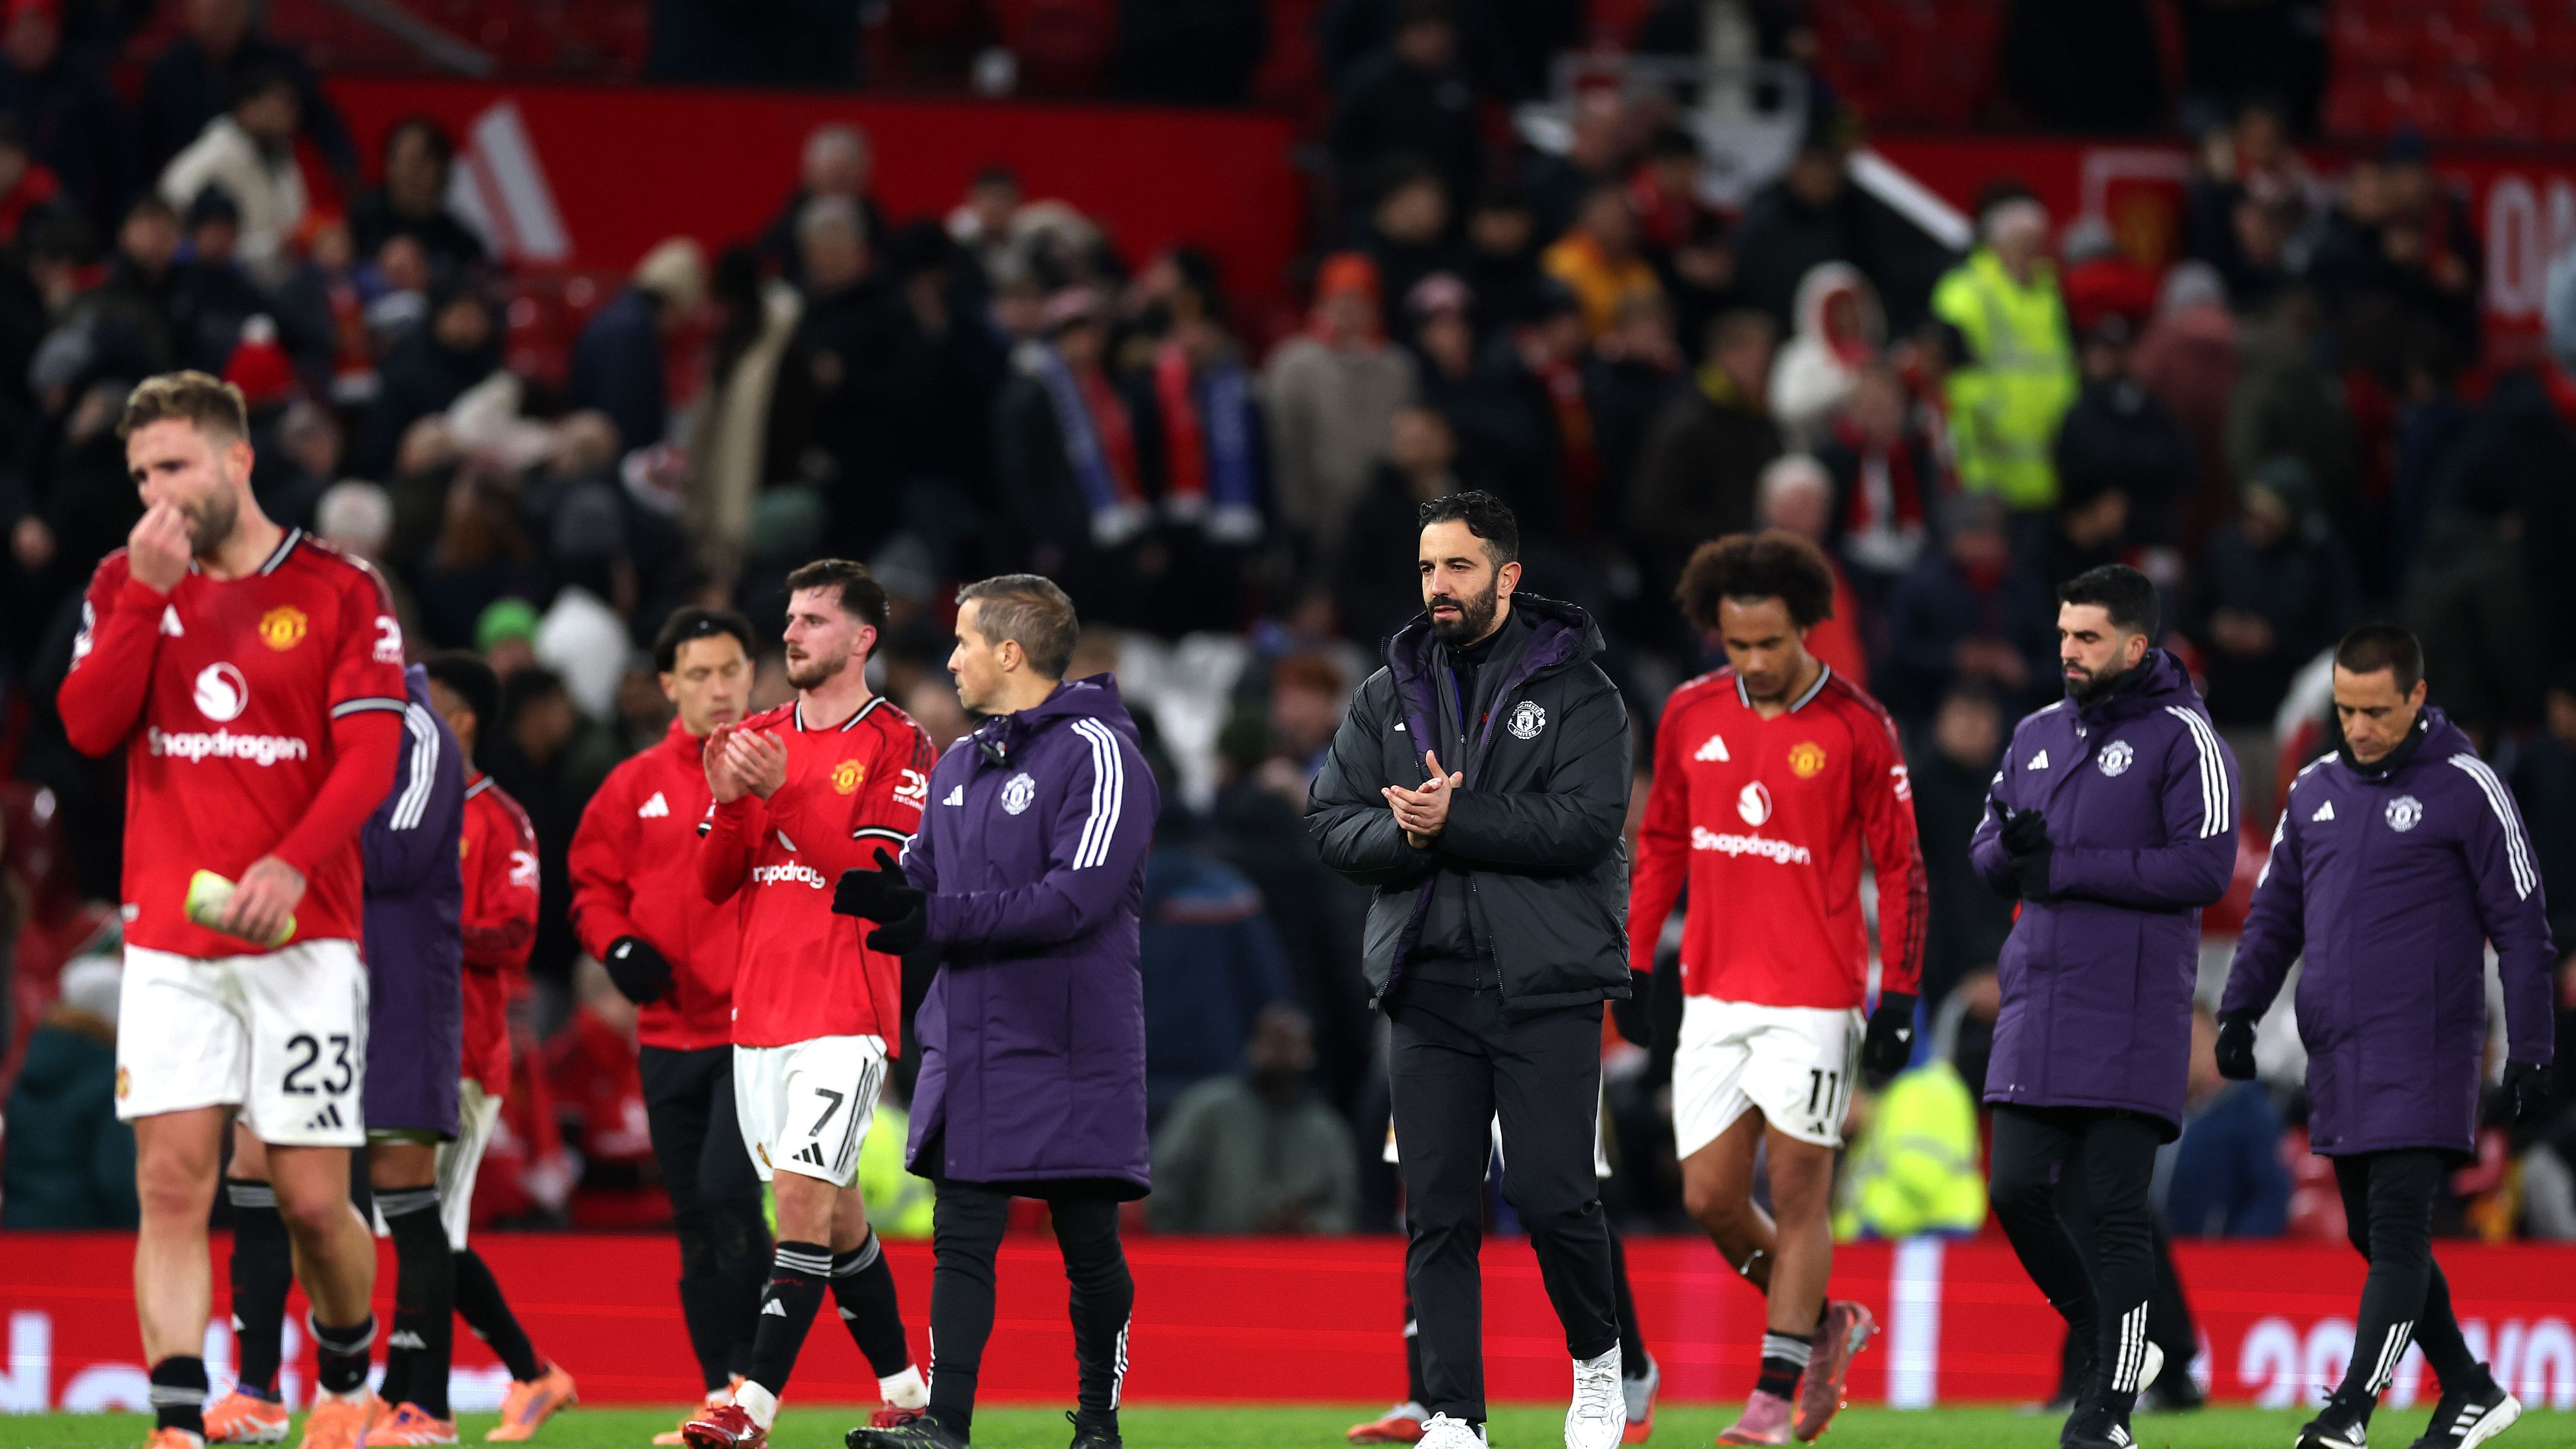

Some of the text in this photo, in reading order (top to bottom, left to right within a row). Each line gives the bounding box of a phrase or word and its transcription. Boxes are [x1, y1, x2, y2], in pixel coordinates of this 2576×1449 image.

[1511, 703, 1542, 717] MANCHESTER
[1691, 825, 1811, 865] Snapdragon
[283, 1035, 352, 1094] 23
[808, 1087, 844, 1137] 7
[1807, 1068, 1837, 1119] 11
